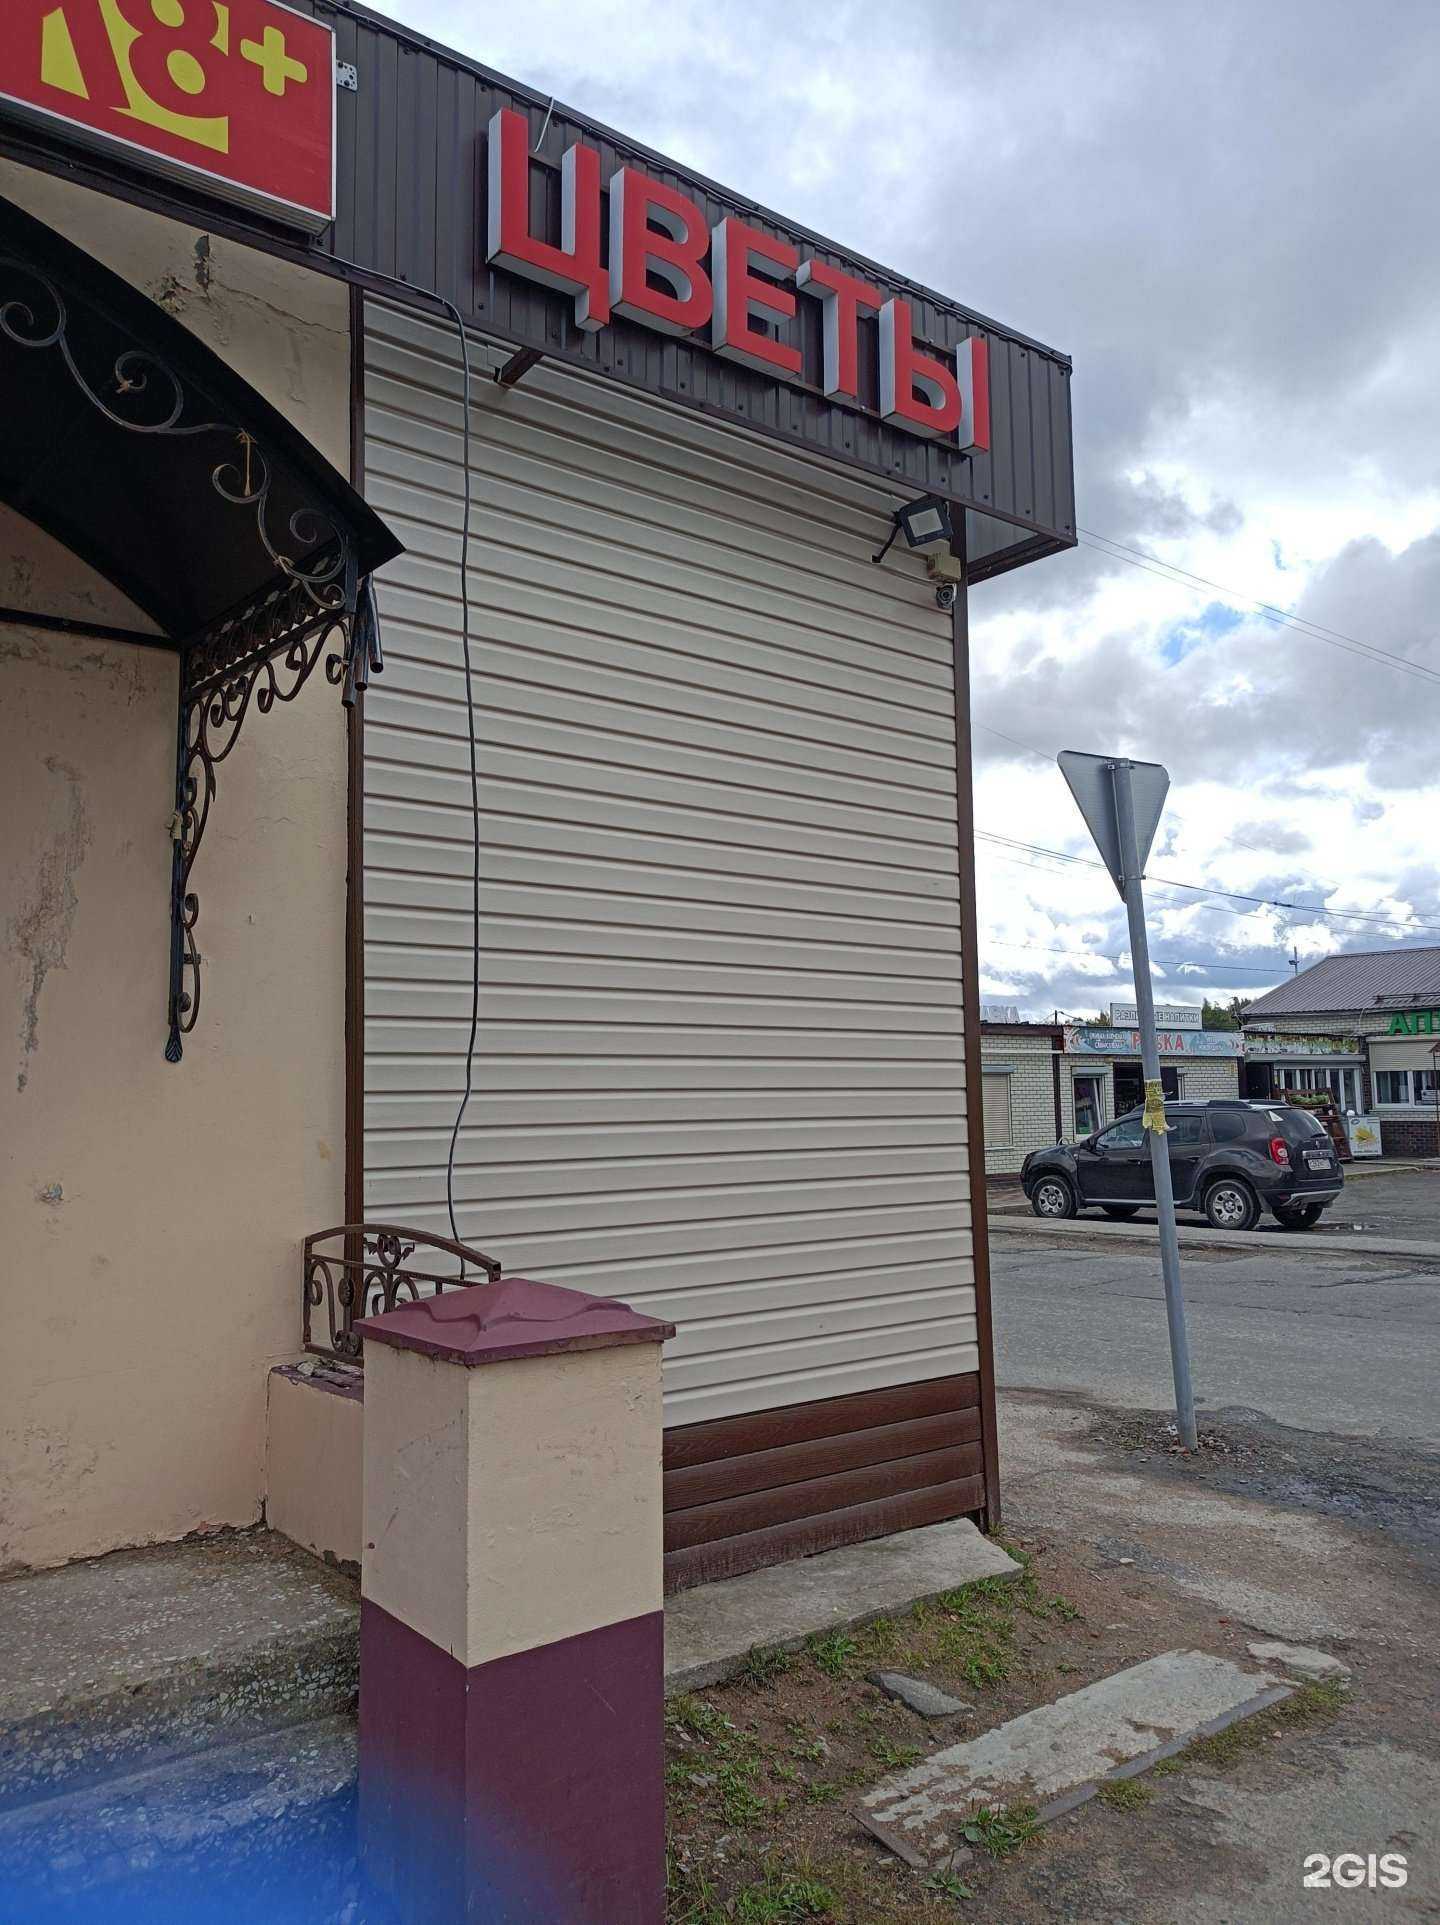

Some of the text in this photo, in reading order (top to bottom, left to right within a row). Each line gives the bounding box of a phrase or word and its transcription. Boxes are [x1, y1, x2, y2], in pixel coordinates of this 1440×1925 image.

[488, 108, 990, 456] ЦВЕТЫ
[1388, 1010, 1440, 1035] АП
[1131, 1031, 1185, 1052] РБКА
